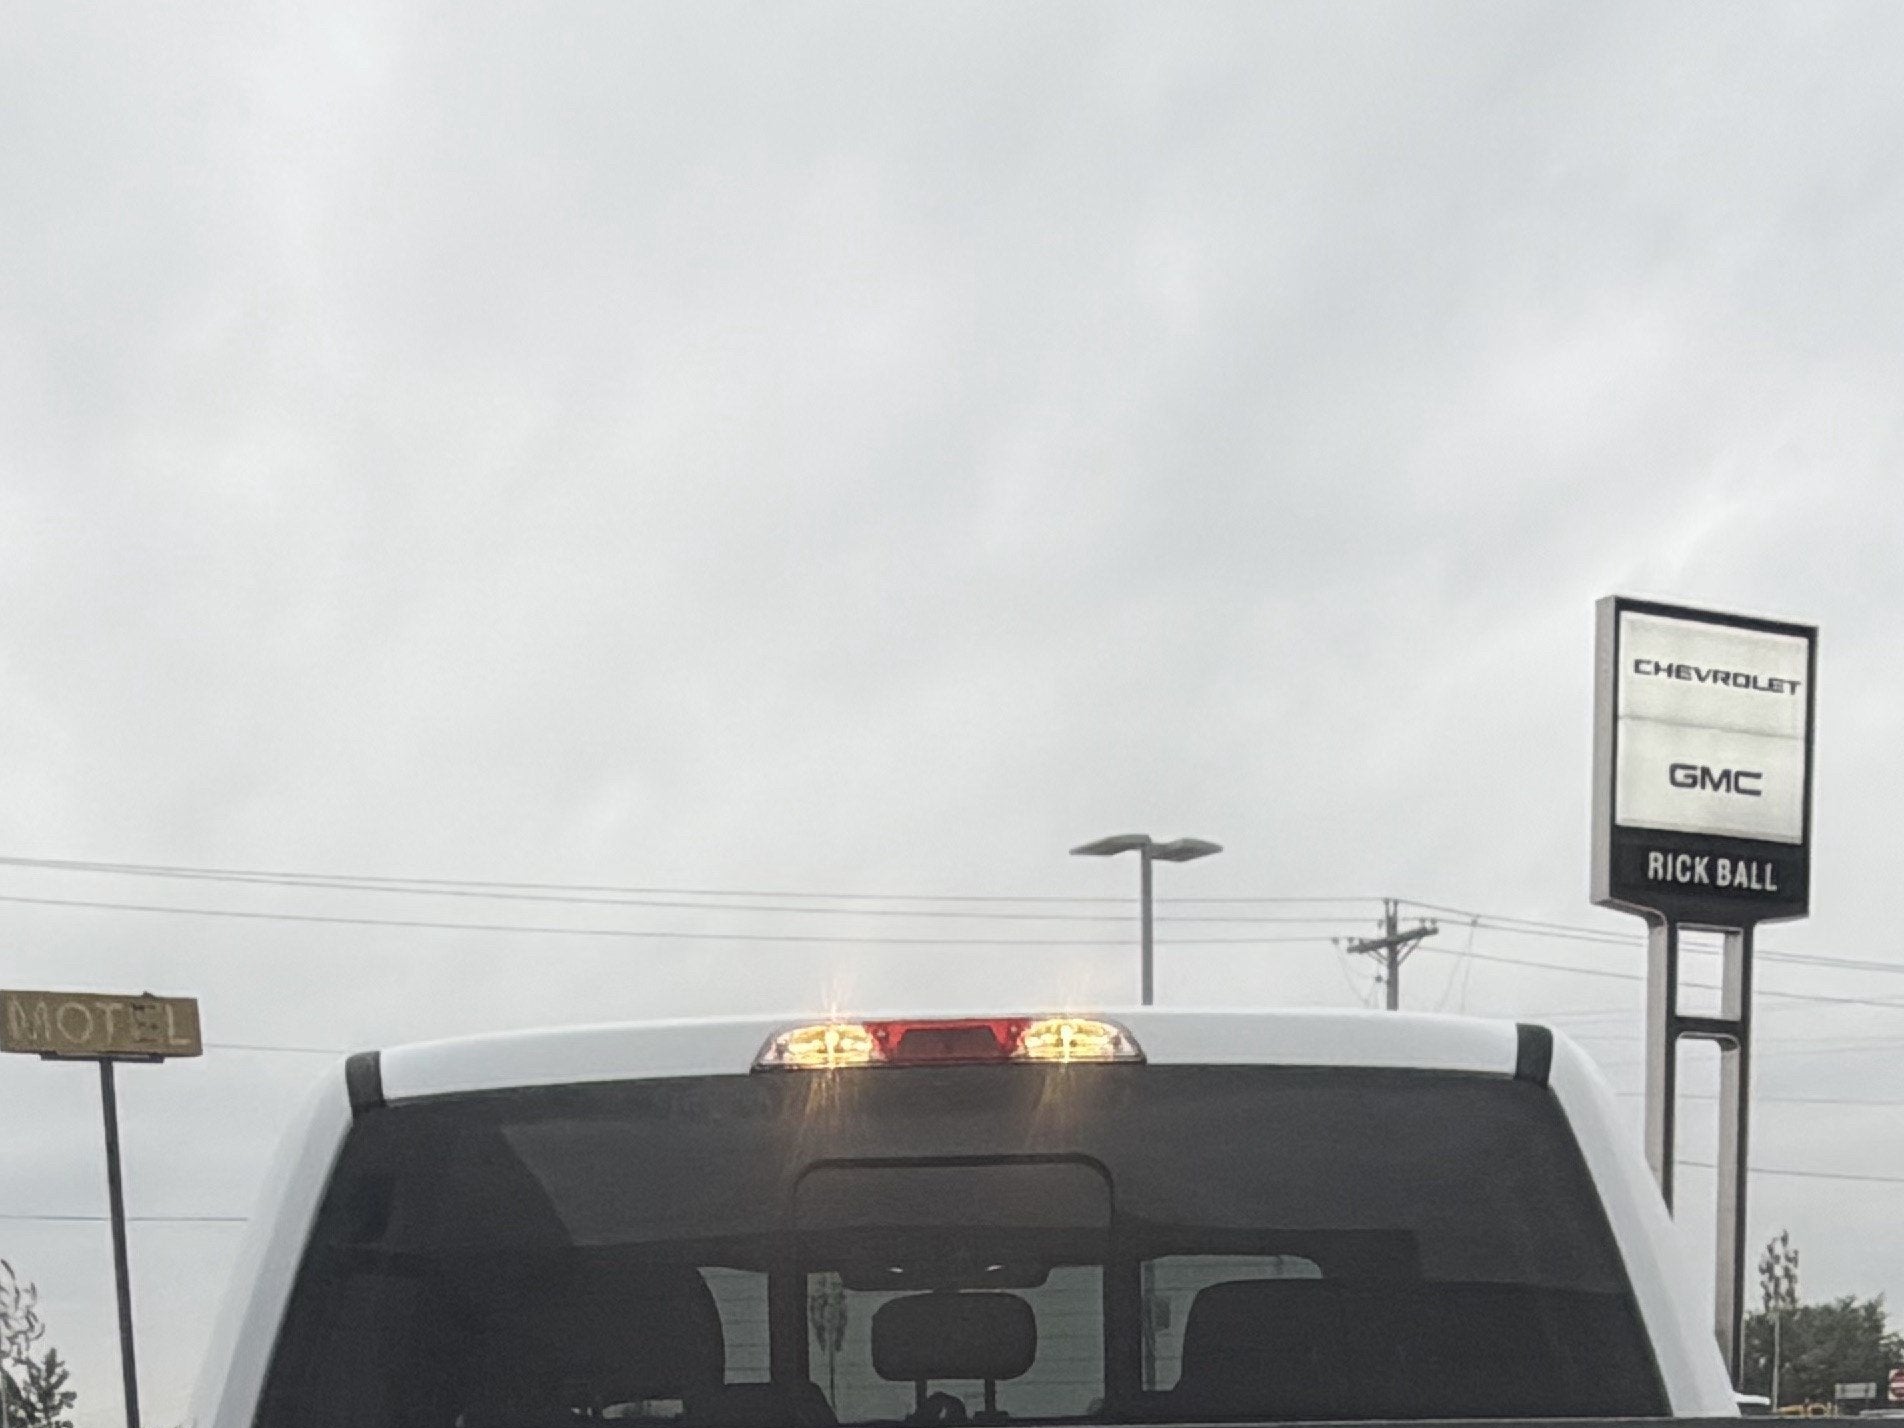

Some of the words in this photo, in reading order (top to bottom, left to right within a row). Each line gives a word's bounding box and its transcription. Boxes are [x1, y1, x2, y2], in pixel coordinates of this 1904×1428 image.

[1633, 658, 1801, 696] CHEVROLET
[1668, 762, 1763, 797] GMC
[1648, 850, 1710, 885] RICK
[1716, 857, 1778, 892] BALL
[6, 995, 192, 1046] MOTEL
